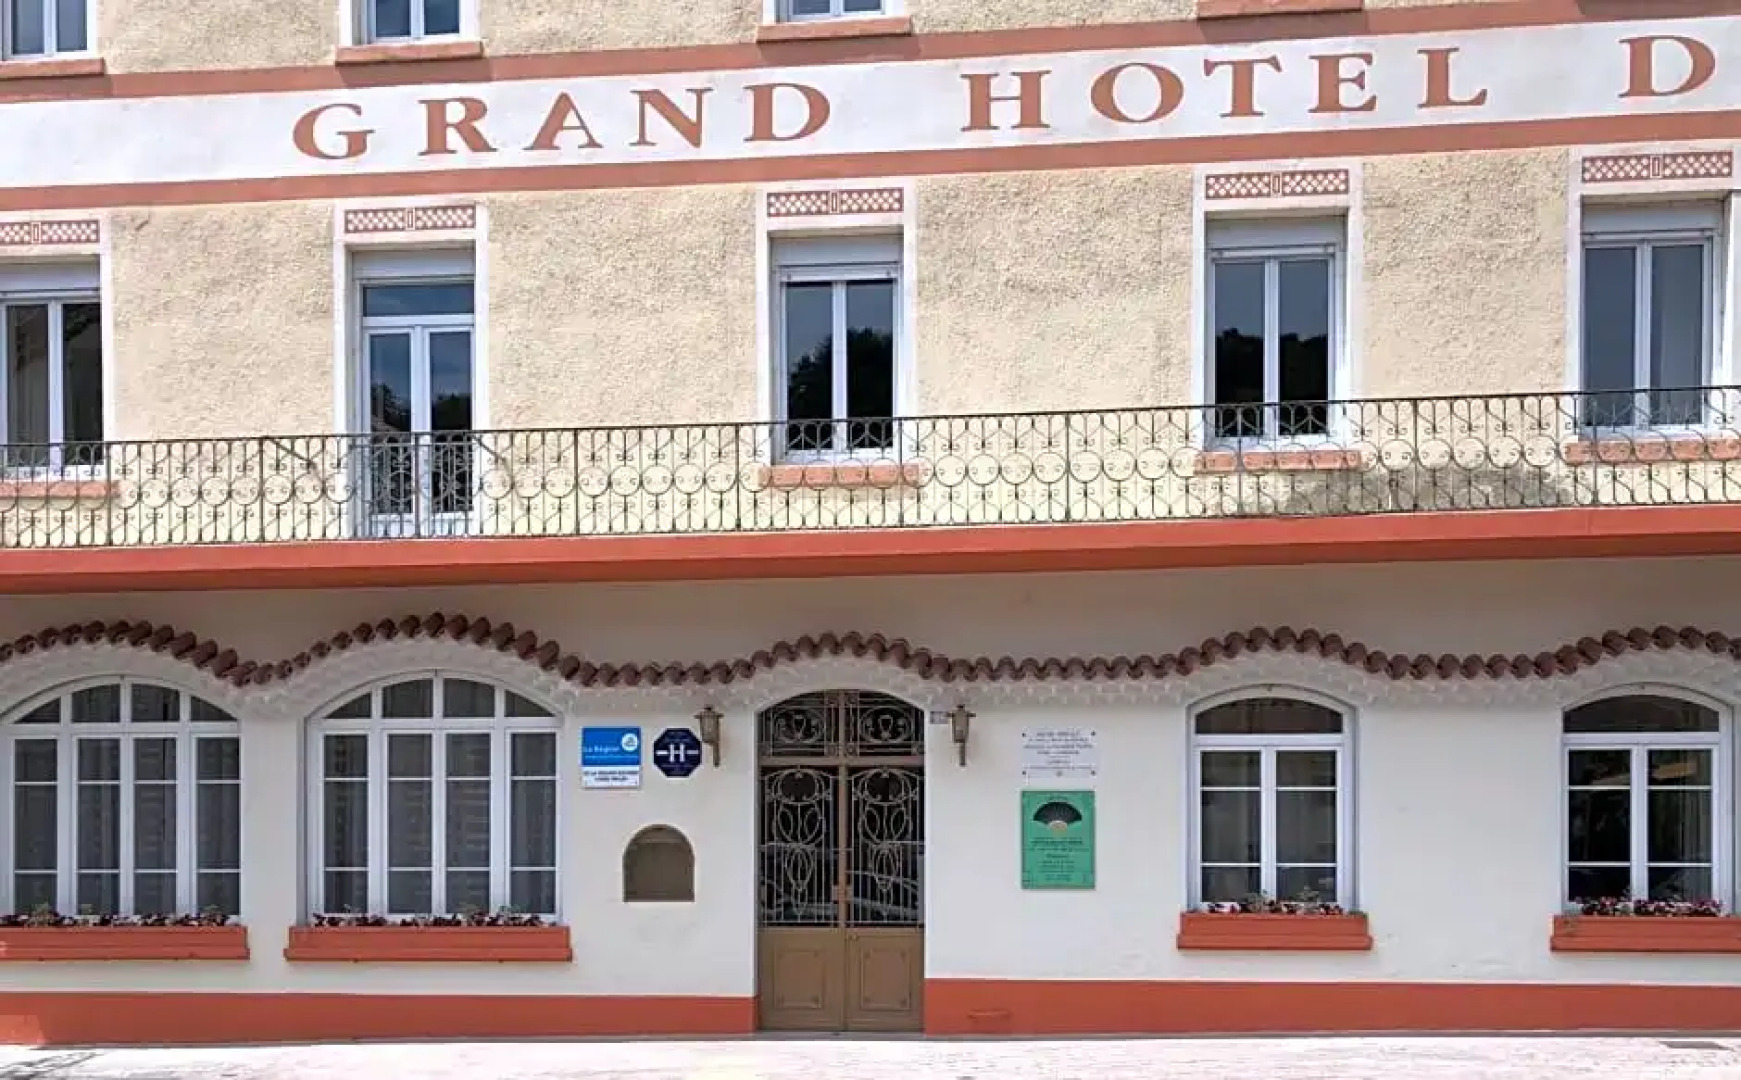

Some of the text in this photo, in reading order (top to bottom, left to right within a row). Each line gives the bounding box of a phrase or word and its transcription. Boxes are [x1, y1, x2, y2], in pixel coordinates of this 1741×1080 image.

[293, 82, 831, 160] GRAND
[960, 47, 1489, 132] HOTEL
[669, 743, 685, 762] H
